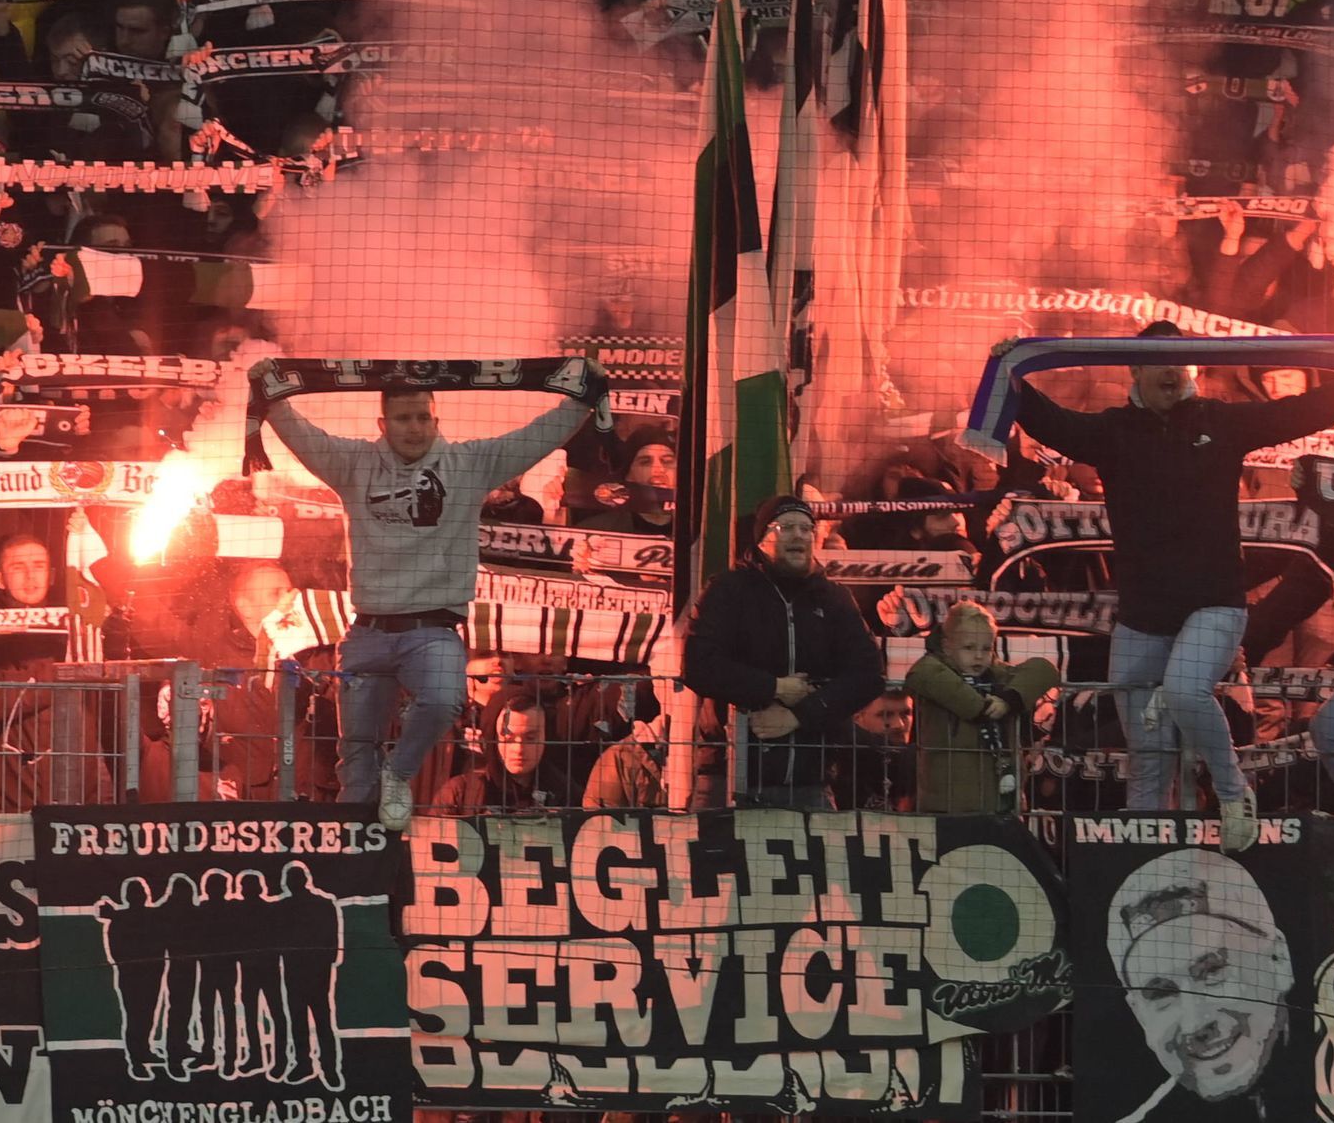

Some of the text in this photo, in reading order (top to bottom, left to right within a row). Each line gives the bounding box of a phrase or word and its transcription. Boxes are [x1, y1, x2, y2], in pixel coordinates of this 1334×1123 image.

[50, 821, 388, 856] FREUNDESKREIS
[1074, 817, 1179, 844] IMMER
[401, 813, 938, 936] BEGLEIT
[403, 926, 925, 1047] SERVICE
[71, 1095, 393, 1123] MÖNCHENGLADBACH
